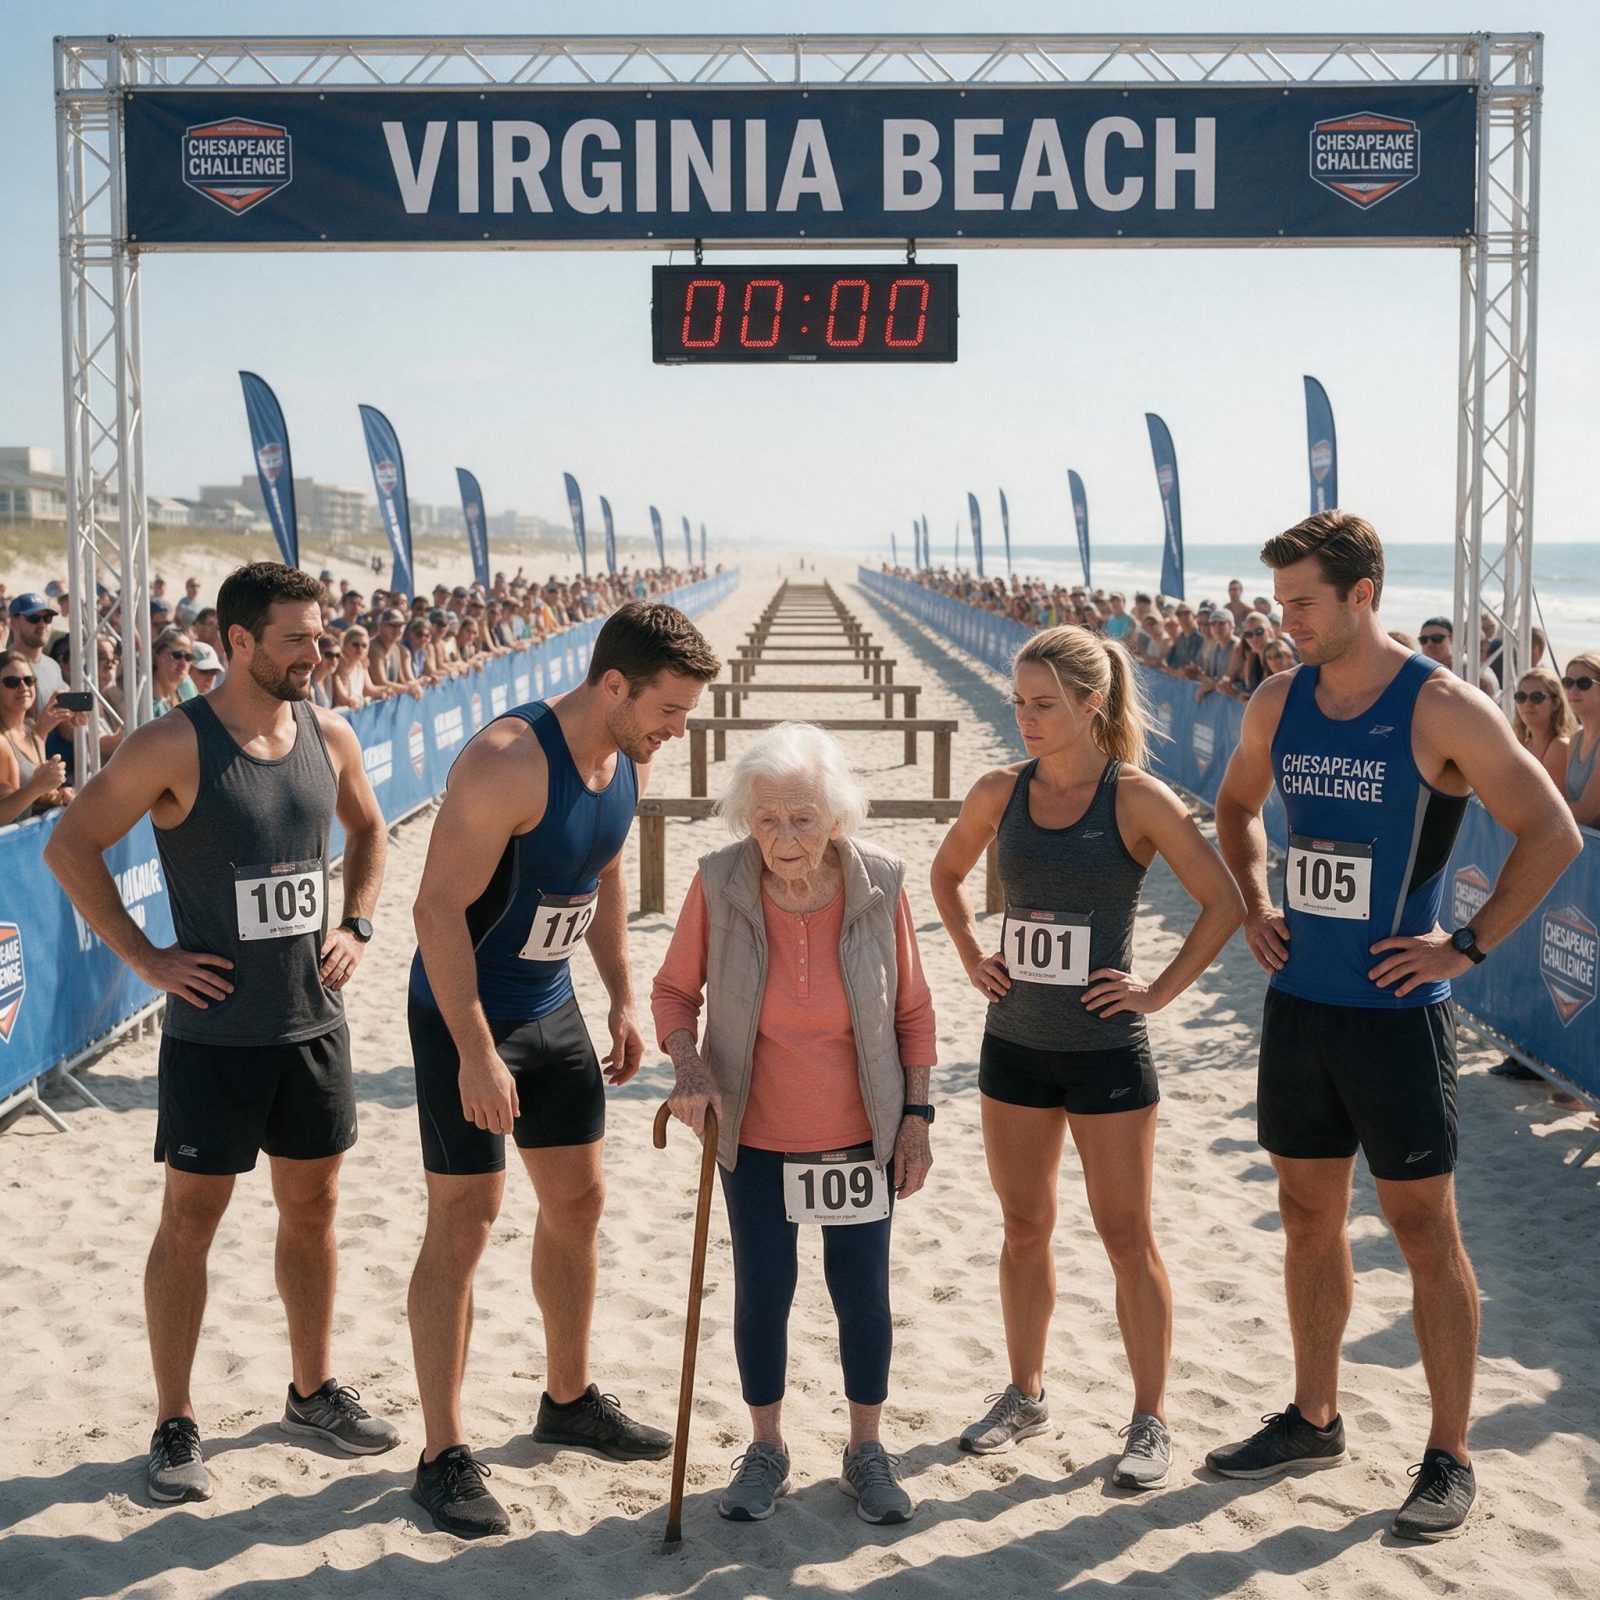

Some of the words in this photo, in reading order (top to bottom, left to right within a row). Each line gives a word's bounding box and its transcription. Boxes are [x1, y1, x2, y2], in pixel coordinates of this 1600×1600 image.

[188, 139, 285, 156] CHESAPEAKE
[1316, 134, 1414, 151] CHESAPEAKE
[1316, 152, 1414, 170] CHALLENGE
[189, 157, 286, 176] CHALLENGE
[382, 118, 844, 214] VIRGINIA
[883, 116, 1216, 212] BEACH
[681, 279, 930, 348] 00:00
[1282, 753, 1387, 781] CHESAPEAKE
[1282, 774, 1383, 803] CHALLENGE
[1296, 855, 1356, 904] 105
[251, 878, 317, 924] 103
[543, 907, 592, 948] 112
[1014, 925, 1072, 971] 101
[1545, 920, 1596, 962] CHESAPEAKE
[1543, 945, 1594, 987] CHALLENGE
[798, 1166, 874, 1210] 109
